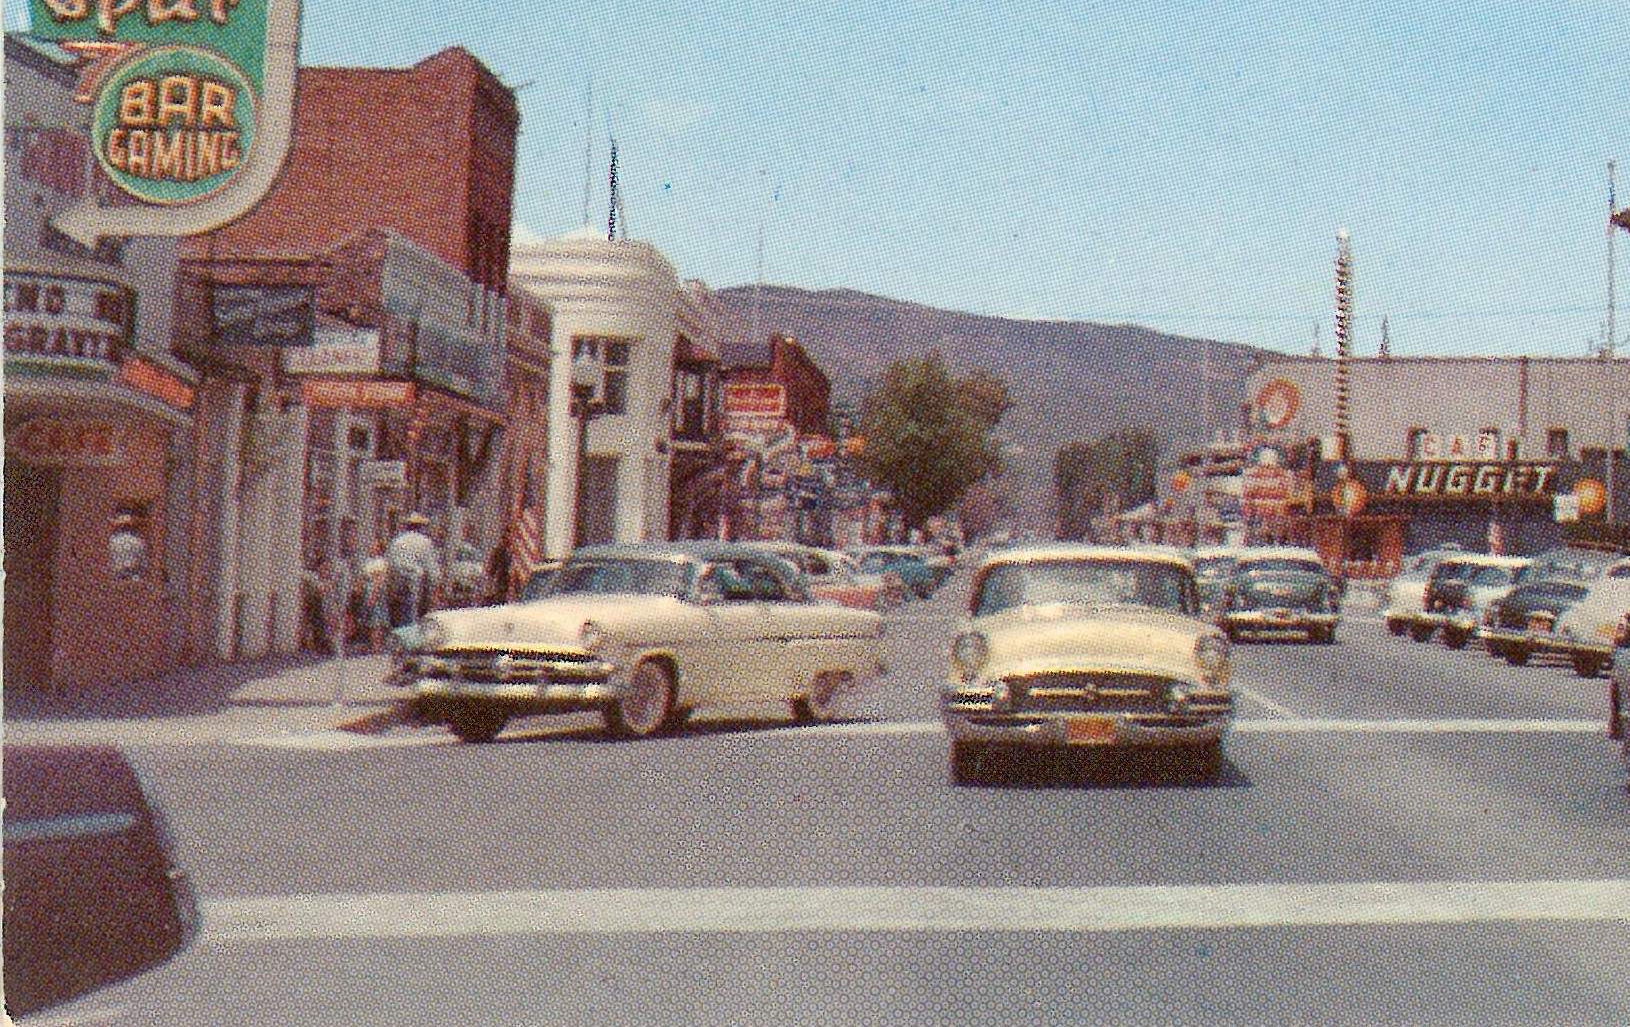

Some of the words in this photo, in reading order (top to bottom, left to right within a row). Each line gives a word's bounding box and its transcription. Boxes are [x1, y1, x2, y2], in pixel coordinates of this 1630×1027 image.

[120, 75, 237, 128] BAR
[108, 128, 241, 180] GAMING
[1384, 466, 1556, 493] NUGGET
